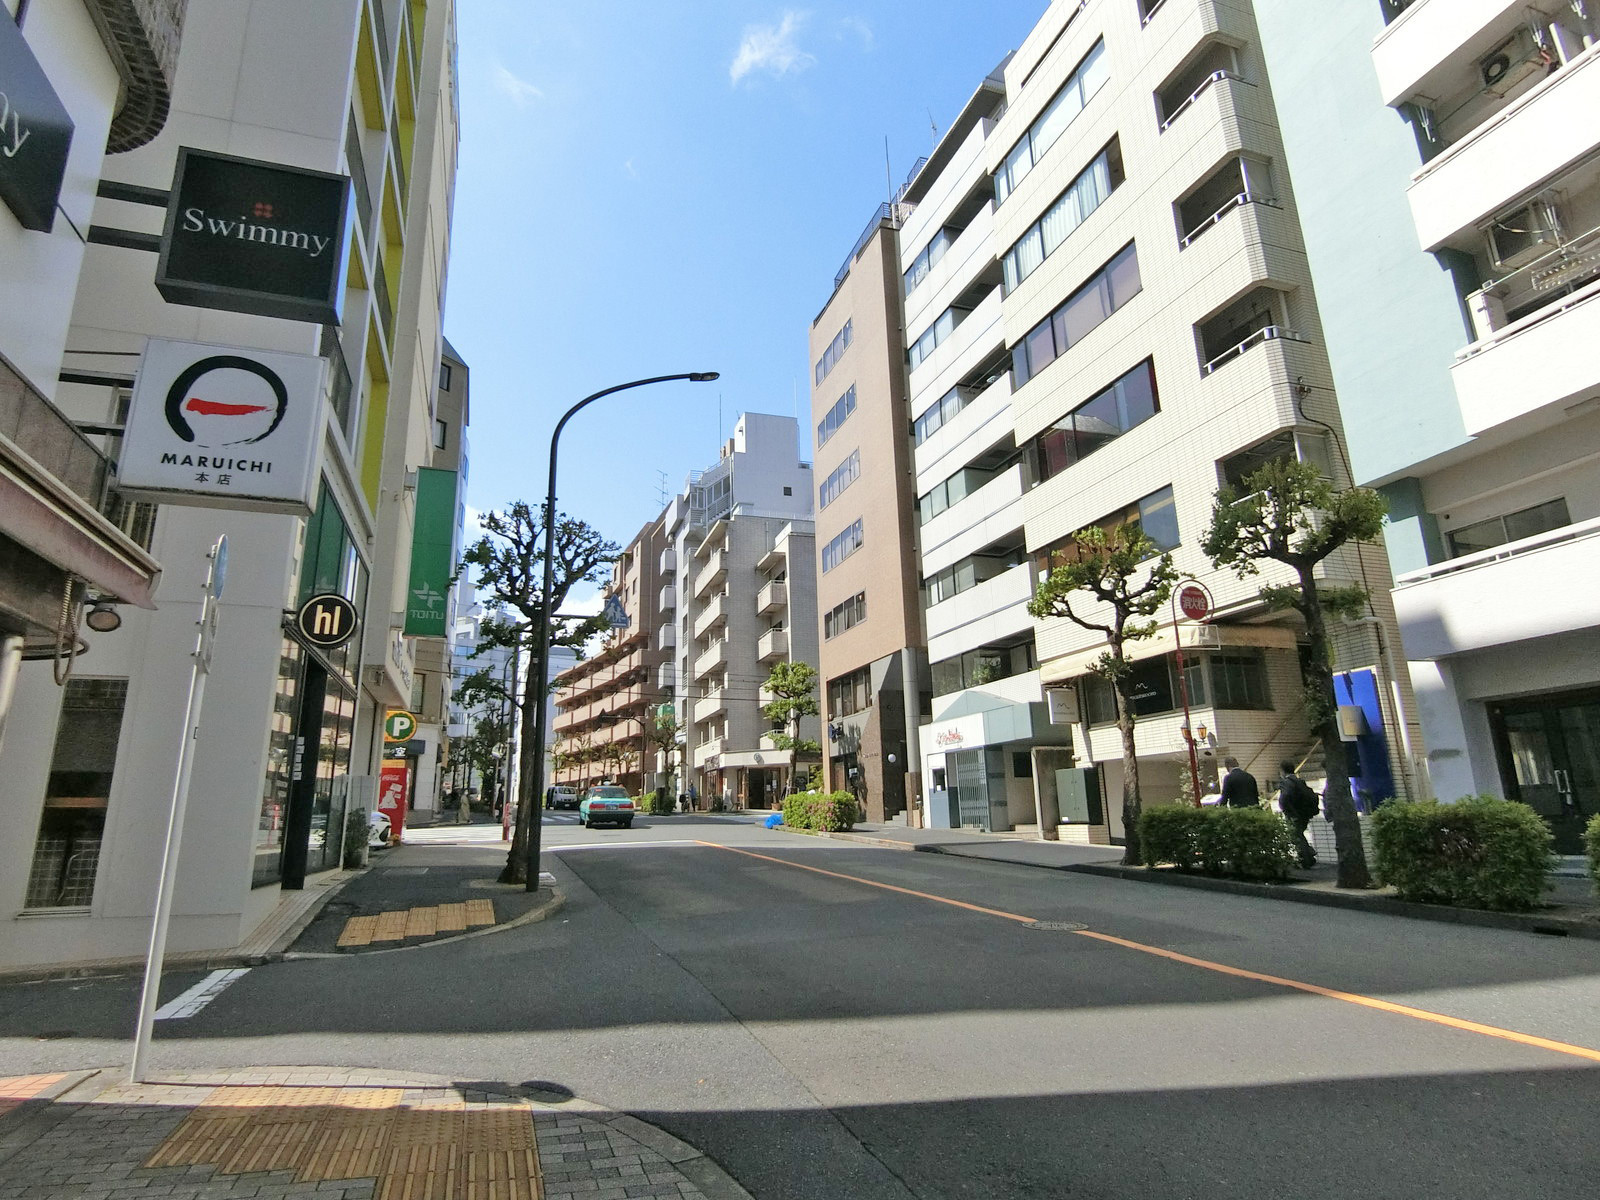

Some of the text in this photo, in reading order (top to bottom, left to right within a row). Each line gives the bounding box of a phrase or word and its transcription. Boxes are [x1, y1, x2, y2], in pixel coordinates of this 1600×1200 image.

[182, 207, 331, 257] Swimmy
[160, 453, 272, 473] MARUICHI
[195, 472, 232, 486] 本店
[1183, 596, 1206, 610] 消火栓
[392, 716, 411, 737] P
